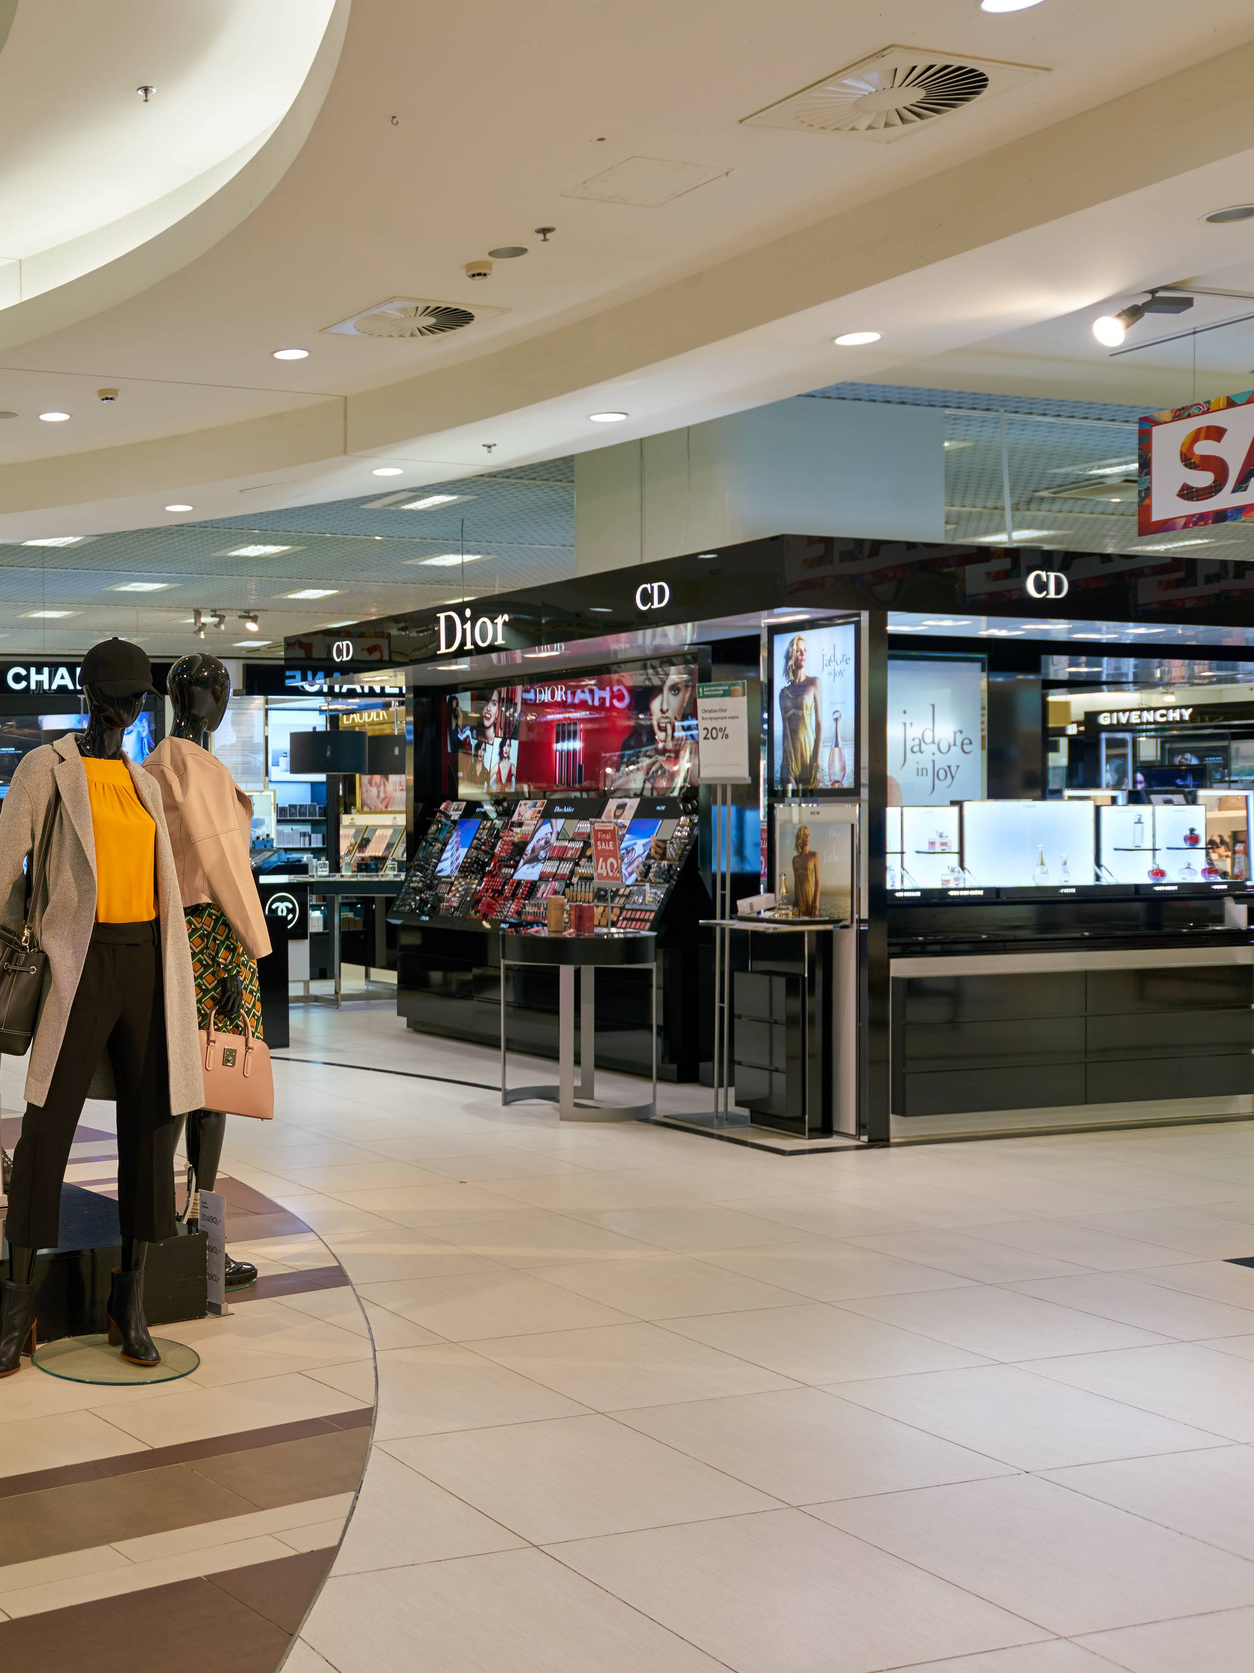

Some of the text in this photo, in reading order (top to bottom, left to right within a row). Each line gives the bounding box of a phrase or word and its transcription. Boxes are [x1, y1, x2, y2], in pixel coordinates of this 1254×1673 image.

[436, 608, 510, 655] Dior
[6, 666, 83, 691] CHA
[535, 685, 566, 703] DIOR
[1098, 707, 1193, 726] GIVENCHY
[703, 727, 729, 740] 20%
[899, 703, 973, 770] j'adore
[916, 751, 960, 796] in joy
[597, 841, 614, 850] SALE
[598, 832, 611, 840] Final
[597, 857, 620, 877] 40%
